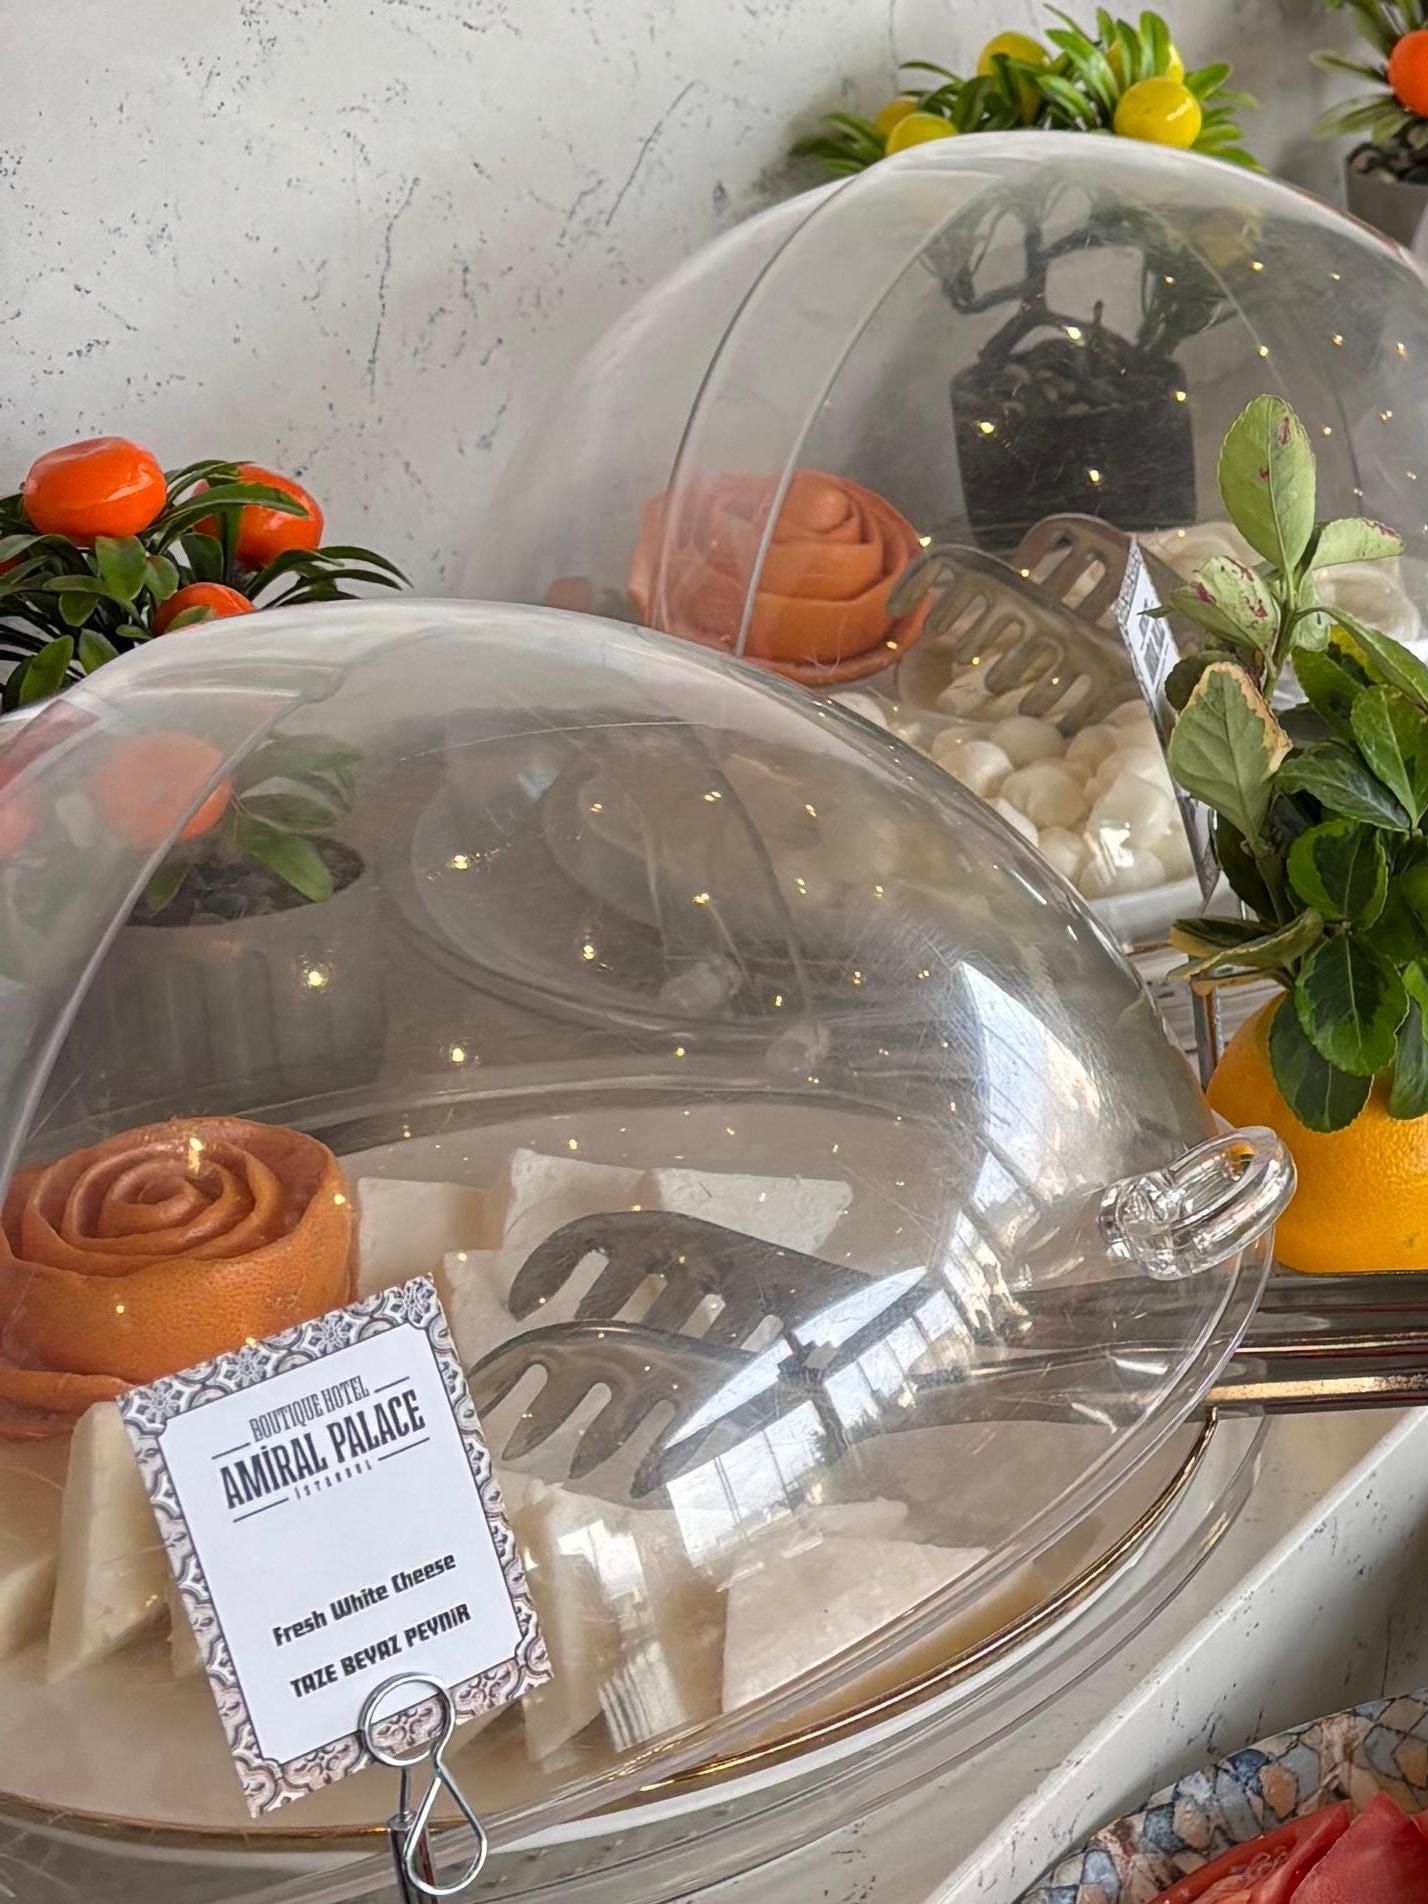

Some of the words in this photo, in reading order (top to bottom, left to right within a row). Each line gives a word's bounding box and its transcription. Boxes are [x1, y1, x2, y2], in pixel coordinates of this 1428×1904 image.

[249, 1393, 323, 1442] BOUTIQUE
[320, 1375, 370, 1413] HOTEL
[220, 1432, 328, 1509] AMİRAL
[326, 1389, 426, 1464] PALACE
[272, 1610, 328, 1647] Fresh
[330, 1584, 390, 1620] White
[391, 1554, 456, 1593] Cheese
[290, 1664, 338, 1697] TAZE
[340, 1634, 402, 1676] BEYAZ
